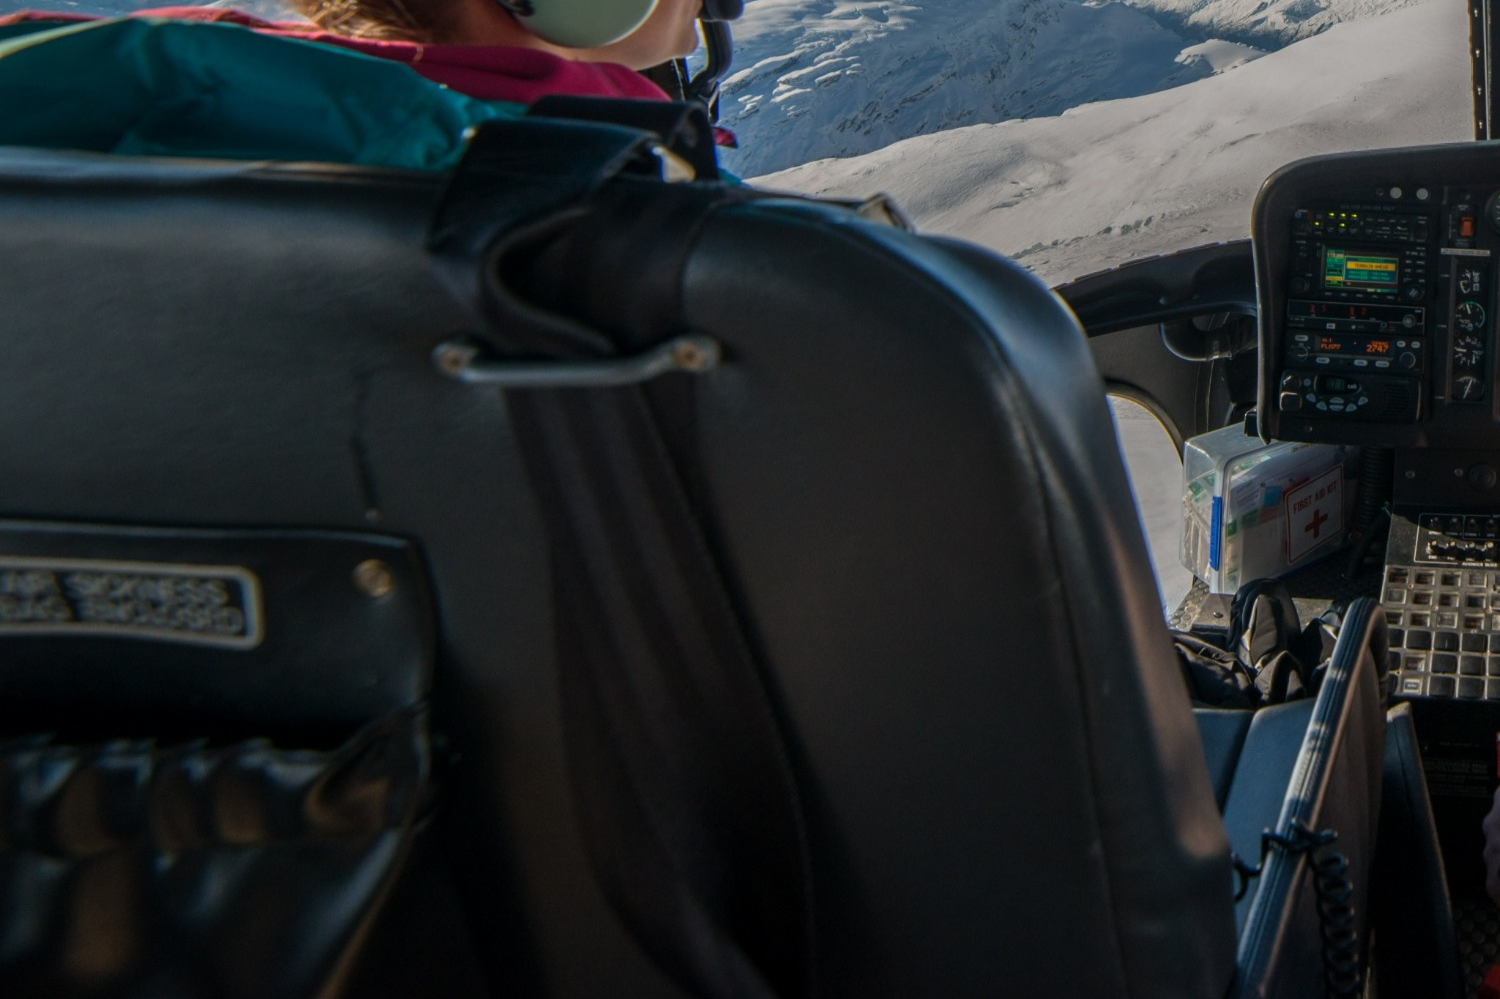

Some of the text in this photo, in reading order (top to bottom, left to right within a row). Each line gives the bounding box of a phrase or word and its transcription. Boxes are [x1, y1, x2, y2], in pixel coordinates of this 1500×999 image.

[1366, 344, 1389, 353] 2747
[1293, 480, 1337, 514] FIRST AID KIT
